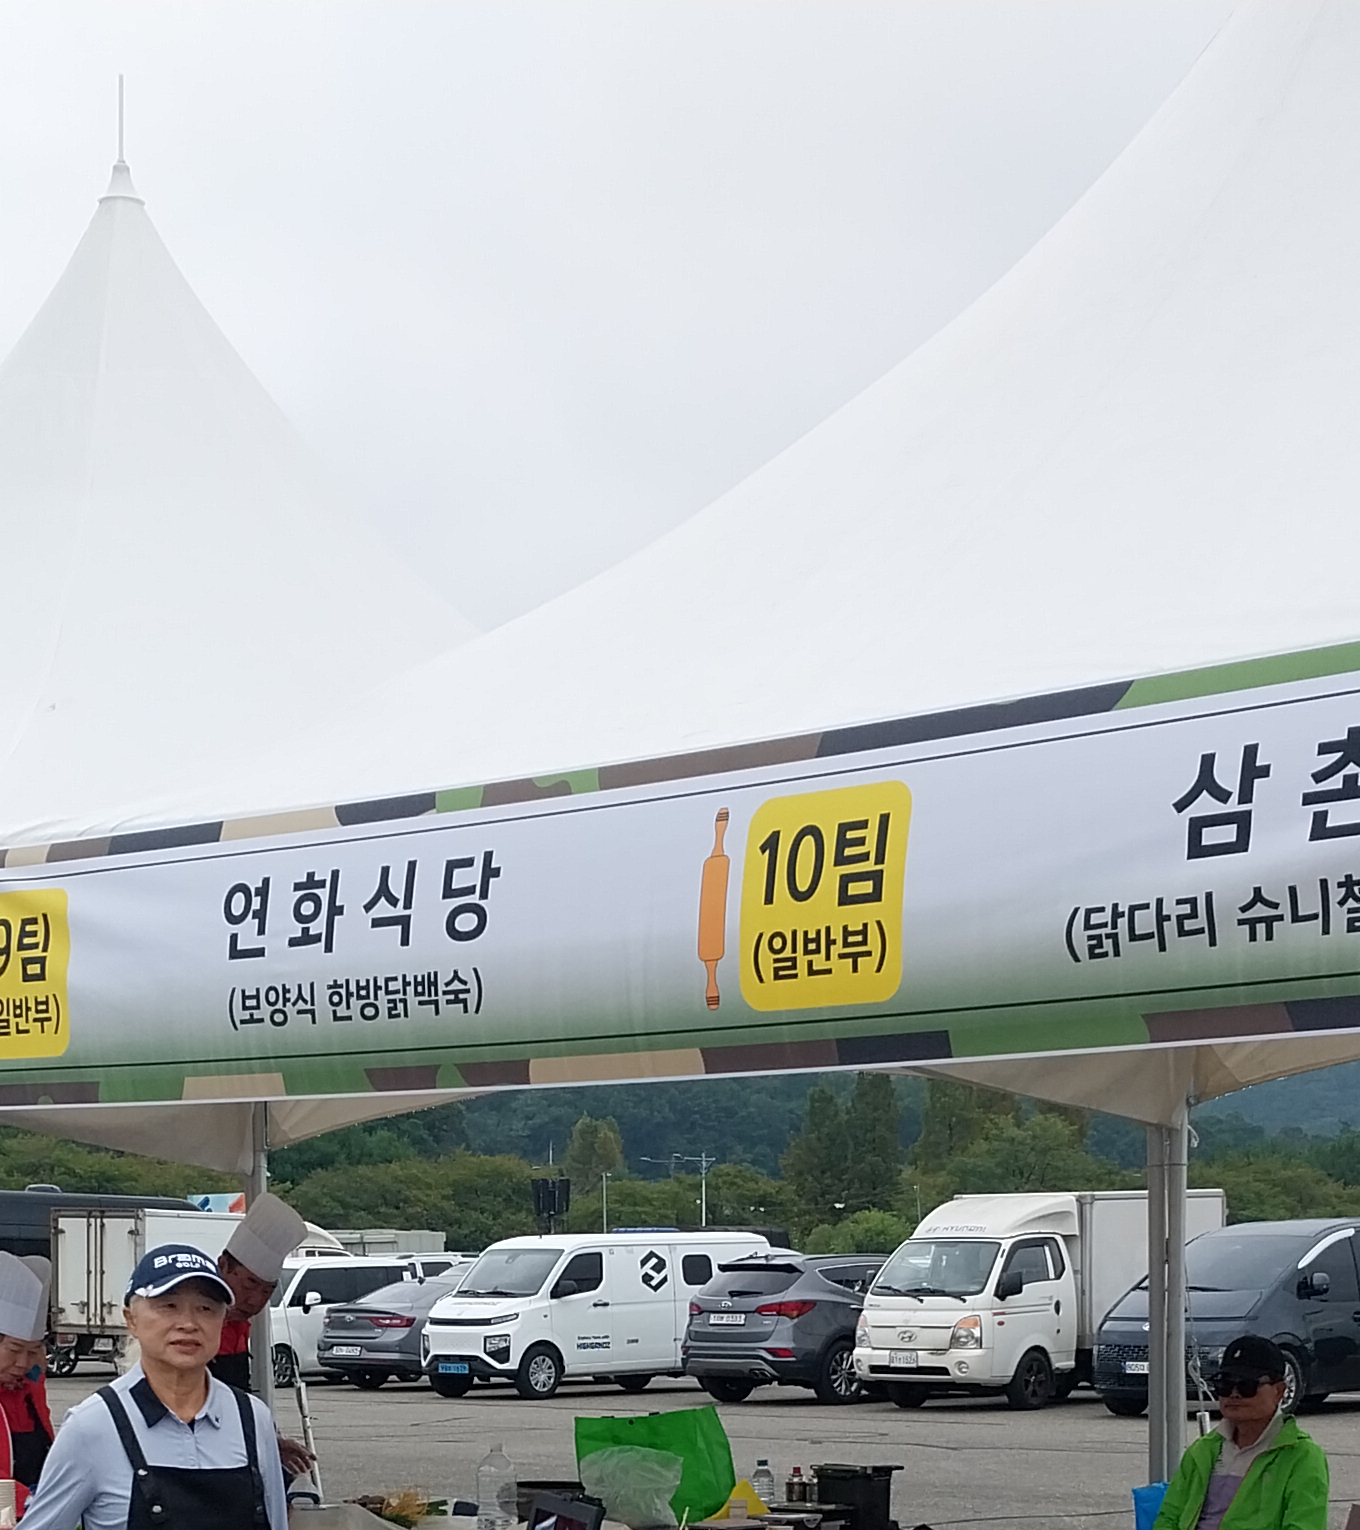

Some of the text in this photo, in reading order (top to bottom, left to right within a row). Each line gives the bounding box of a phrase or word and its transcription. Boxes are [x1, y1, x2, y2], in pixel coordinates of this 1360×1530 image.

[756, 811, 892, 909] 10팀
[222, 849, 502, 961] 연화식당
[1065, 889, 1218, 964] (닭다리
[751, 920, 888, 984] (일반부)
[227, 965, 483, 1032] (보양식 한방닭백숙)
